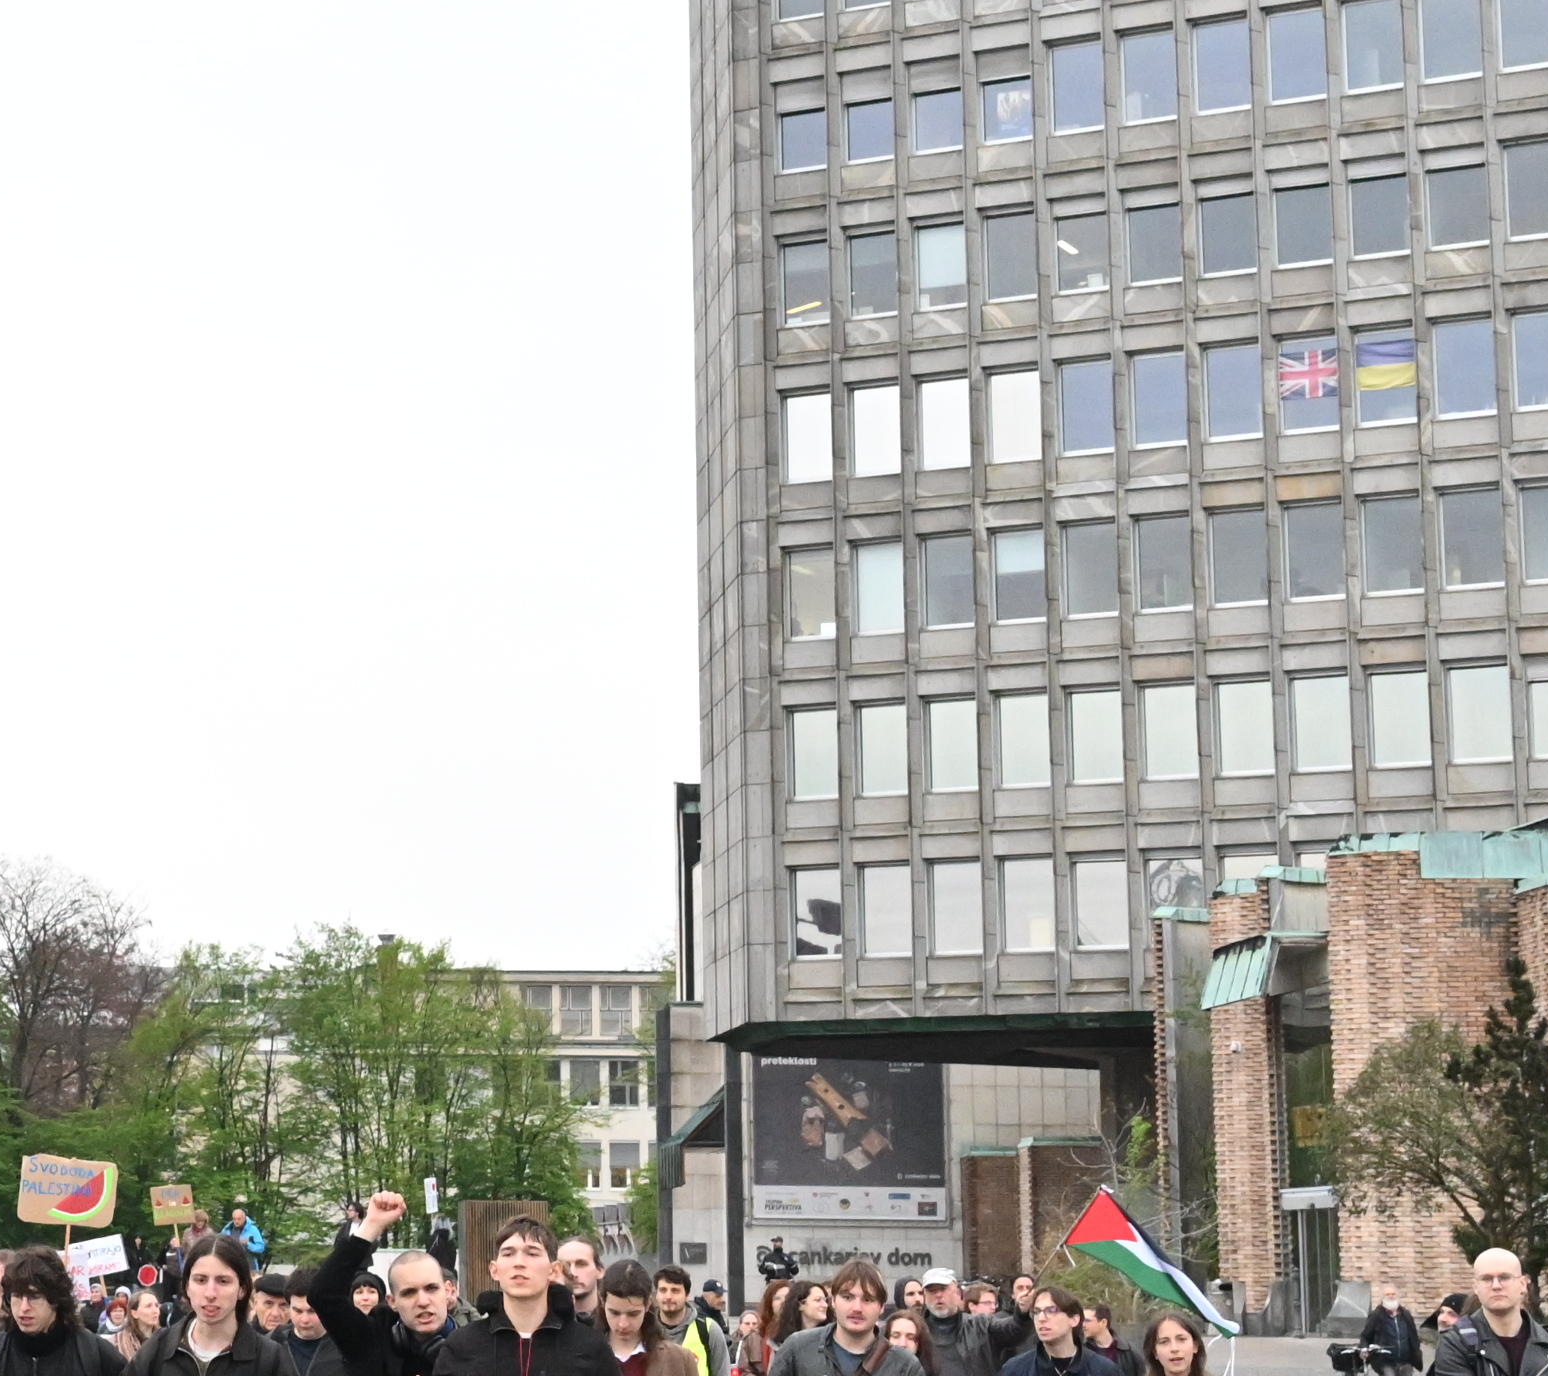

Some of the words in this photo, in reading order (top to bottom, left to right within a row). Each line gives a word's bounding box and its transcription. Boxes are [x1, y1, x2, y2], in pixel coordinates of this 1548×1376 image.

[761, 1057, 817, 1067] preteklosti
[29, 1157, 95, 1178] SVOBODA
[887, 1247, 933, 1267] dom
